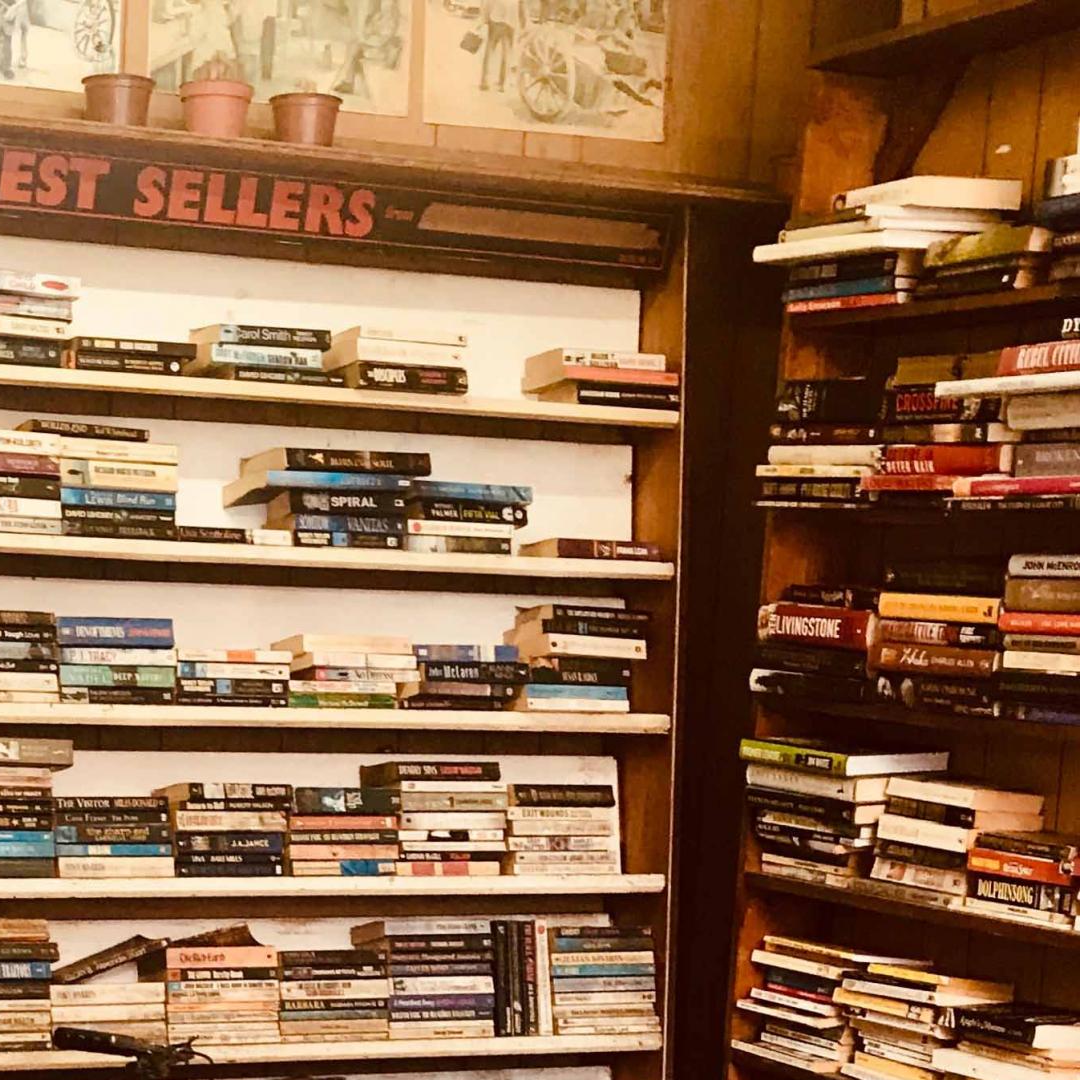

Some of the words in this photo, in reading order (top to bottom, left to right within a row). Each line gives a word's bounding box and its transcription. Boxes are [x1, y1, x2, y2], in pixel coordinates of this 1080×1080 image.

[132, 165, 376, 239] SELLERS
[262, 330, 291, 343] Smith
[330, 496, 378, 511] SPIRAL
[1022, 561, 1044, 571] JOHN
[775, 614, 842, 639] LIVINGSTONE
[443, 665, 479, 680] McLaren
[77, 798, 110, 809] VISITOR
[131, 826, 150, 837] end
